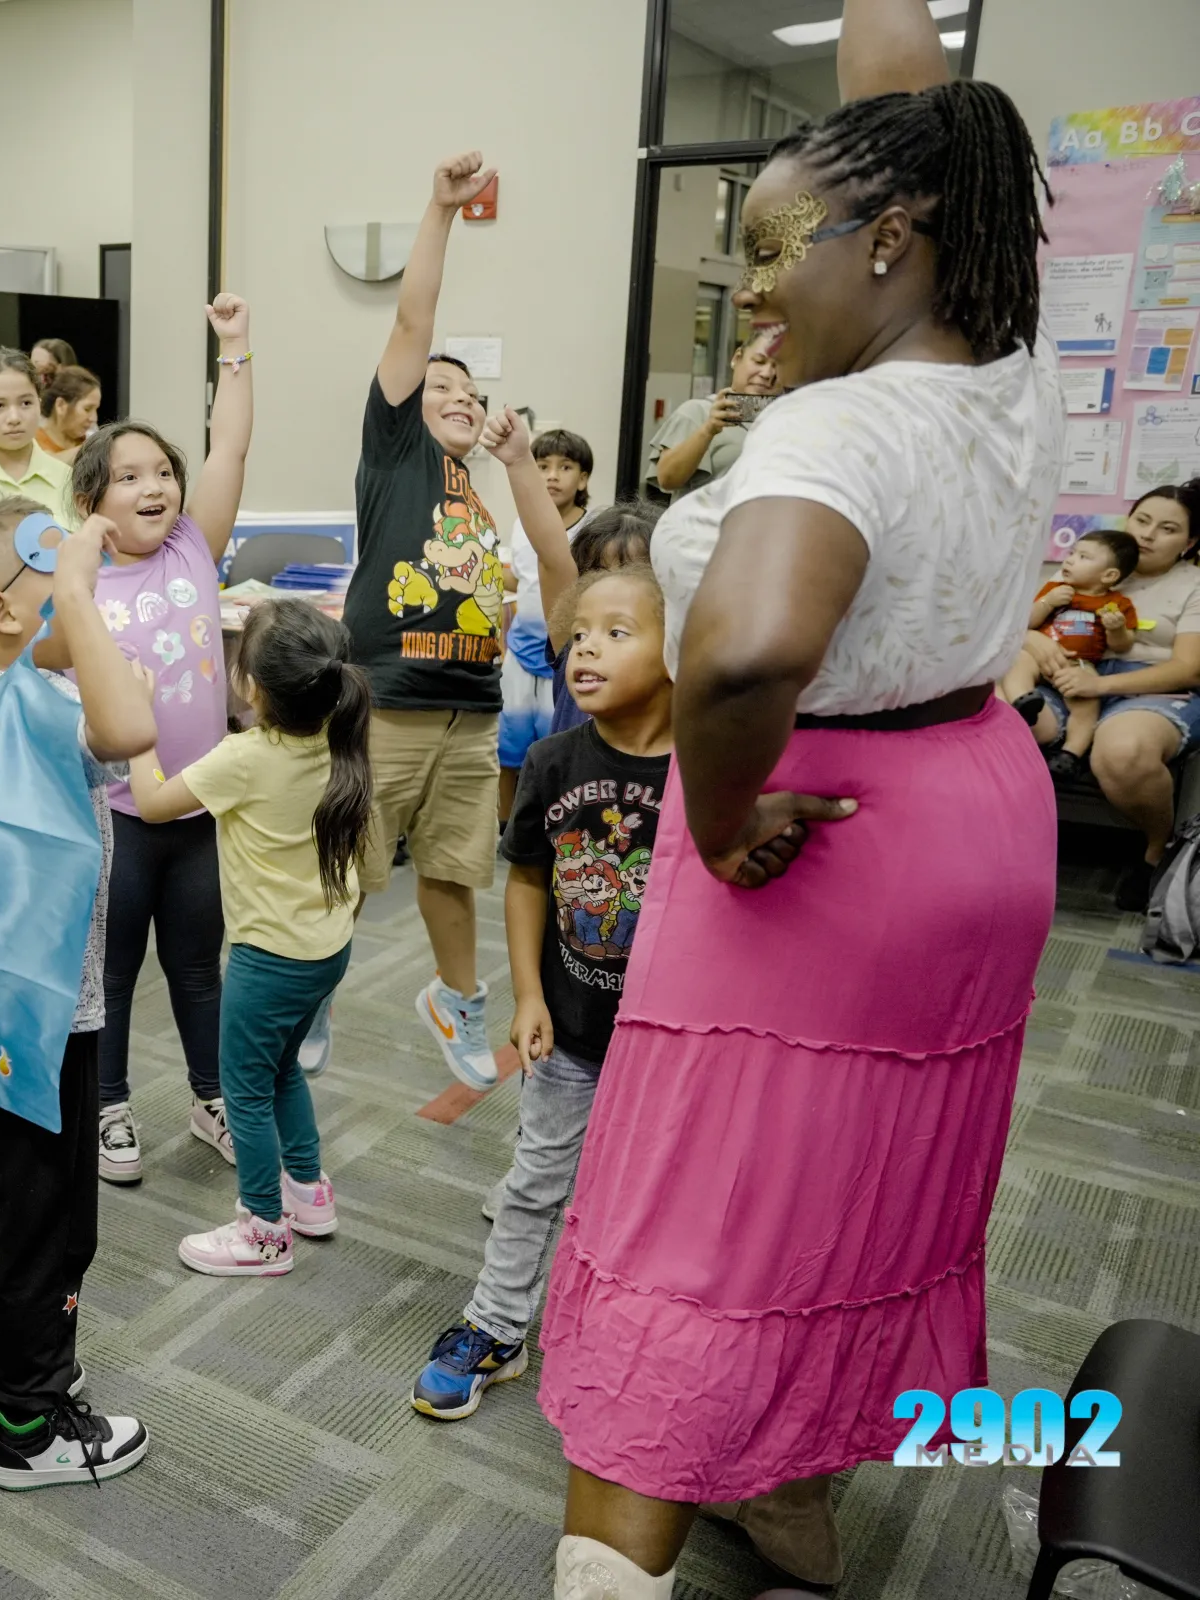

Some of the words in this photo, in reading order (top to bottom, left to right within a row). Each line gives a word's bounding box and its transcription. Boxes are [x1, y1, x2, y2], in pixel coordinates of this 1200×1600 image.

[1059, 128, 1103, 151] Aa
[1119, 116, 1163, 144] Bb
[400, 631, 436, 659] KING
[438, 632, 456, 660] OF
[457, 634, 480, 662] THE
[622, 781, 663, 814] PL
[587, 967, 627, 992] MA
